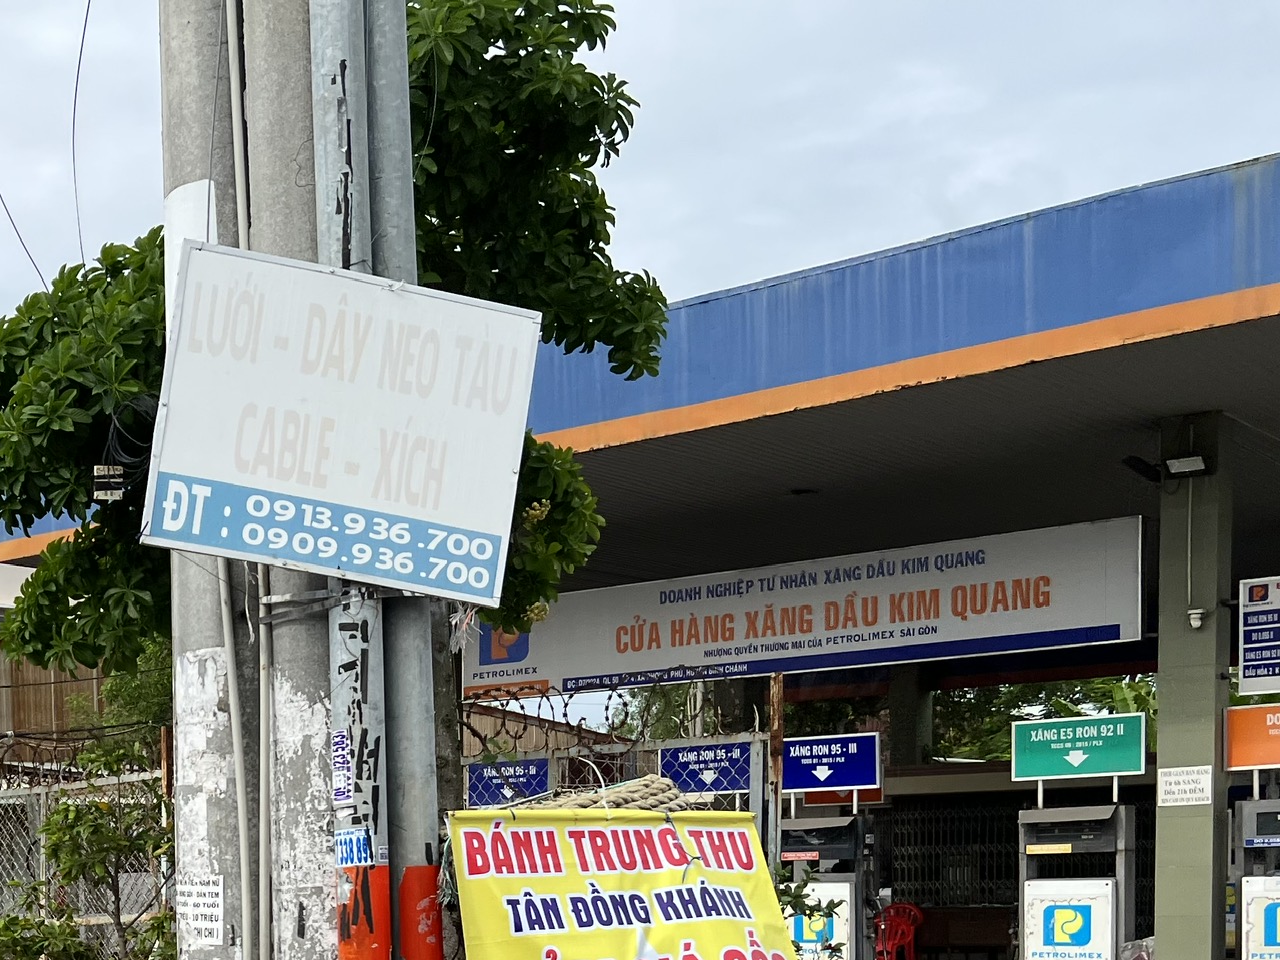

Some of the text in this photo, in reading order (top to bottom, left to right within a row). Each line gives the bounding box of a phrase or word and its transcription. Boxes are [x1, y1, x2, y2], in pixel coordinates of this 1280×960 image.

[300, 293, 373, 385] DÂY
[377, 319, 440, 400] NEO
[233, 402, 335, 489] CABLE
[371, 415, 448, 511] XÍCH
[162, 479, 212, 535] ĐT
[660, 588, 702, 605] DOANH
[706, 579, 753, 599] NGHIỆP
[780, 571, 817, 590] NHÂN
[901, 556, 929, 575] KIM
[934, 549, 986, 573] QUANG
[615, 575, 1051, 655] CỬA HÀNG XĂNG DẦU KIM QUANG
[826, 629, 895, 646] PETROLIMEX
[900, 625, 916, 638] SÀI
[918, 624, 938, 636] GÒN
[472, 666, 538, 680] PETROLIMEX
[790, 742, 857, 757] XĂNG RON 95 III
[1030, 723, 1124, 741] XĂNG E5 RON 92 II
[463, 821, 755, 876] BÁNH TRUNG THU
[200, 911, 219, 924] TRIỆU
[506, 880, 752, 933] TÂN ĐỒNG KHÁNH
[1031, 951, 1102, 959] PETROLIMEX
